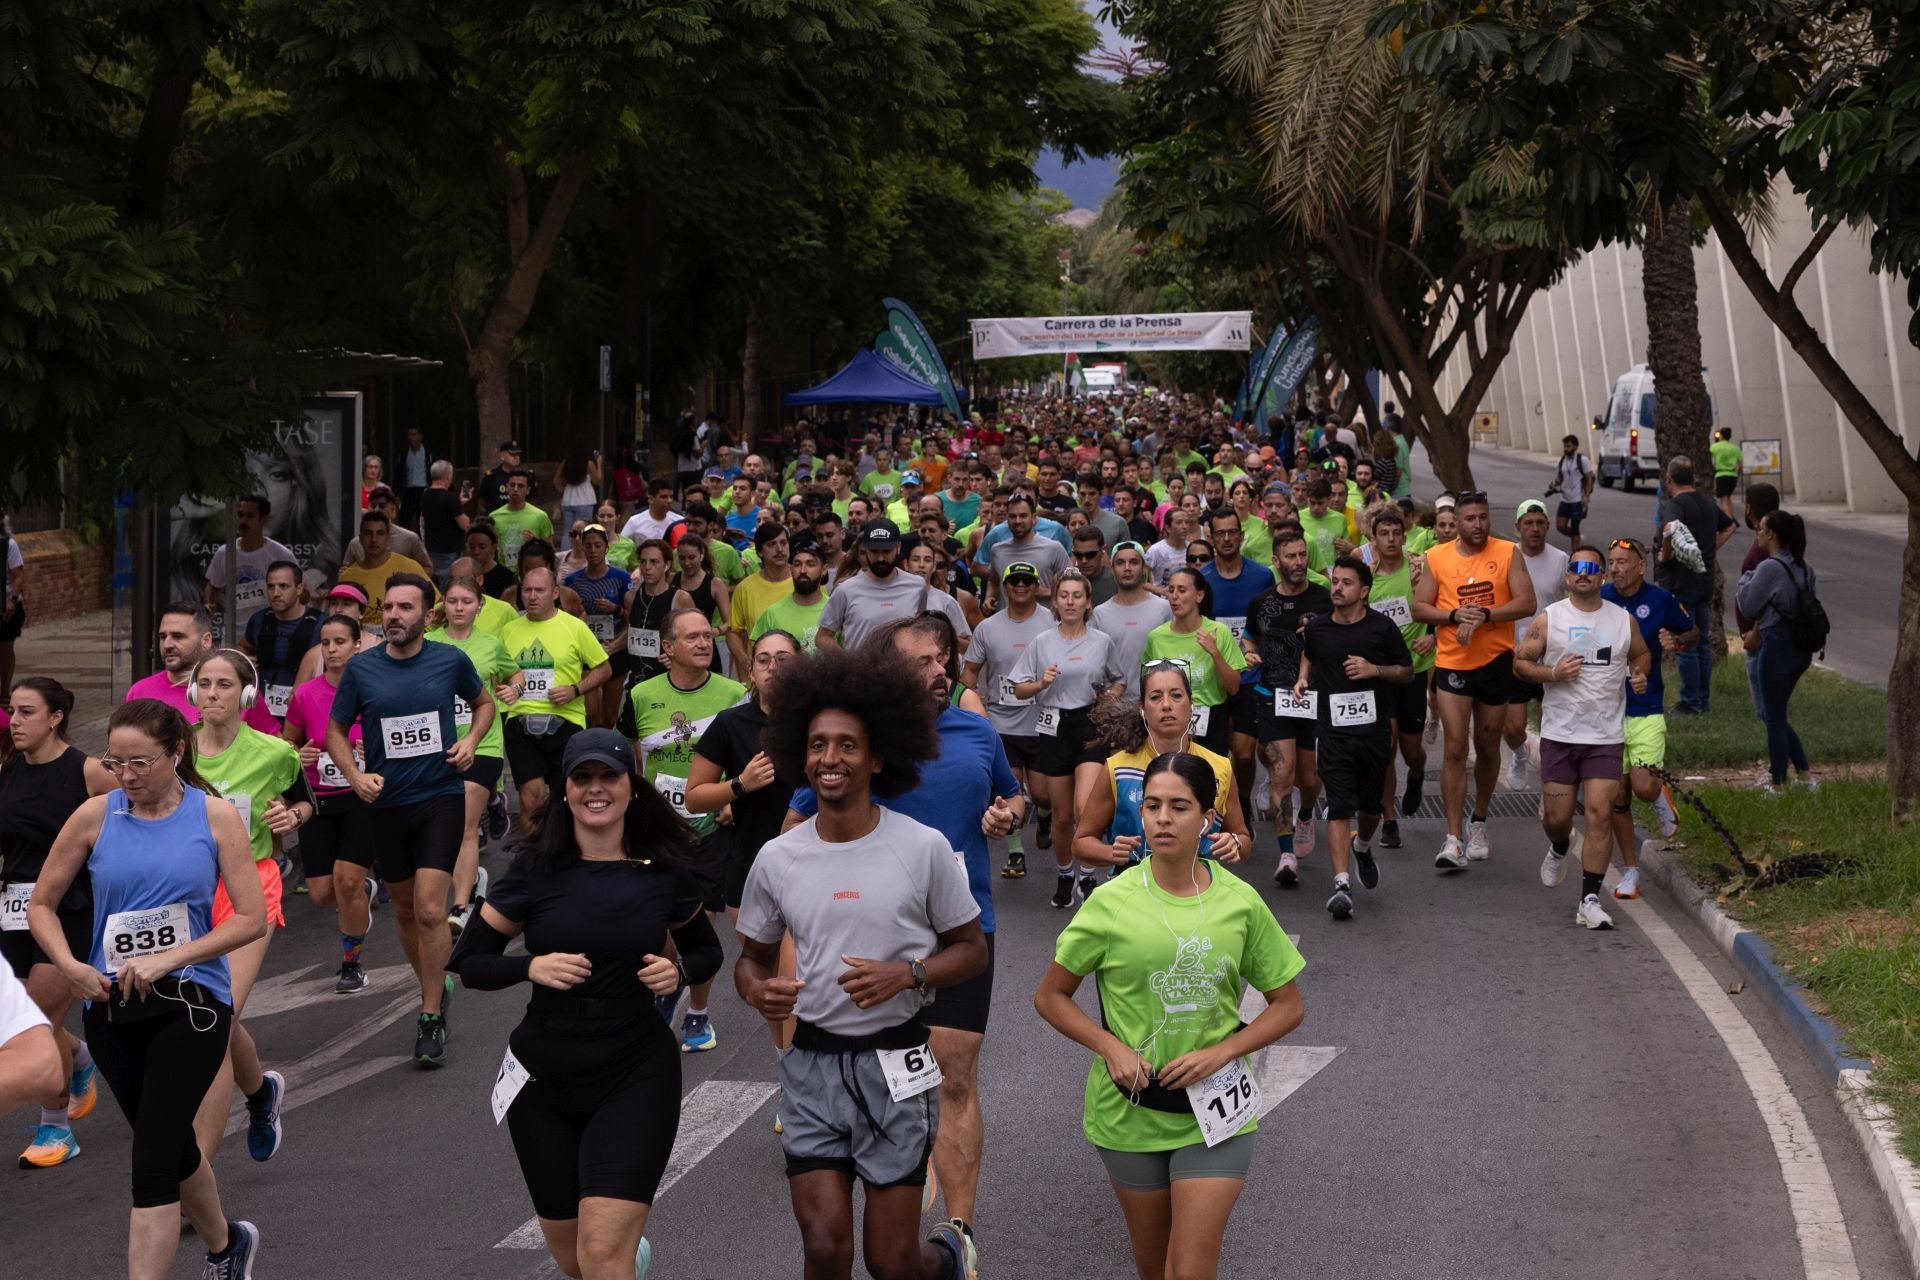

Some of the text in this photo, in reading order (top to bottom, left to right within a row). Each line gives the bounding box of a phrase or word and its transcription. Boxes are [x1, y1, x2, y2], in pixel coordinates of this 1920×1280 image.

[1044, 317, 1182, 330] Carrera de la Prensa
[1136, 329, 1165, 337] Libertad
[1177, 328, 1202, 336] Prensa
[1281, 345, 1316, 390] Unicaja
[630, 636, 656, 647] 1132
[1337, 702, 1369, 717] 754
[390, 727, 431, 746] 956
[114, 925, 176, 954] 838
[1207, 1073, 1252, 1120] 176
